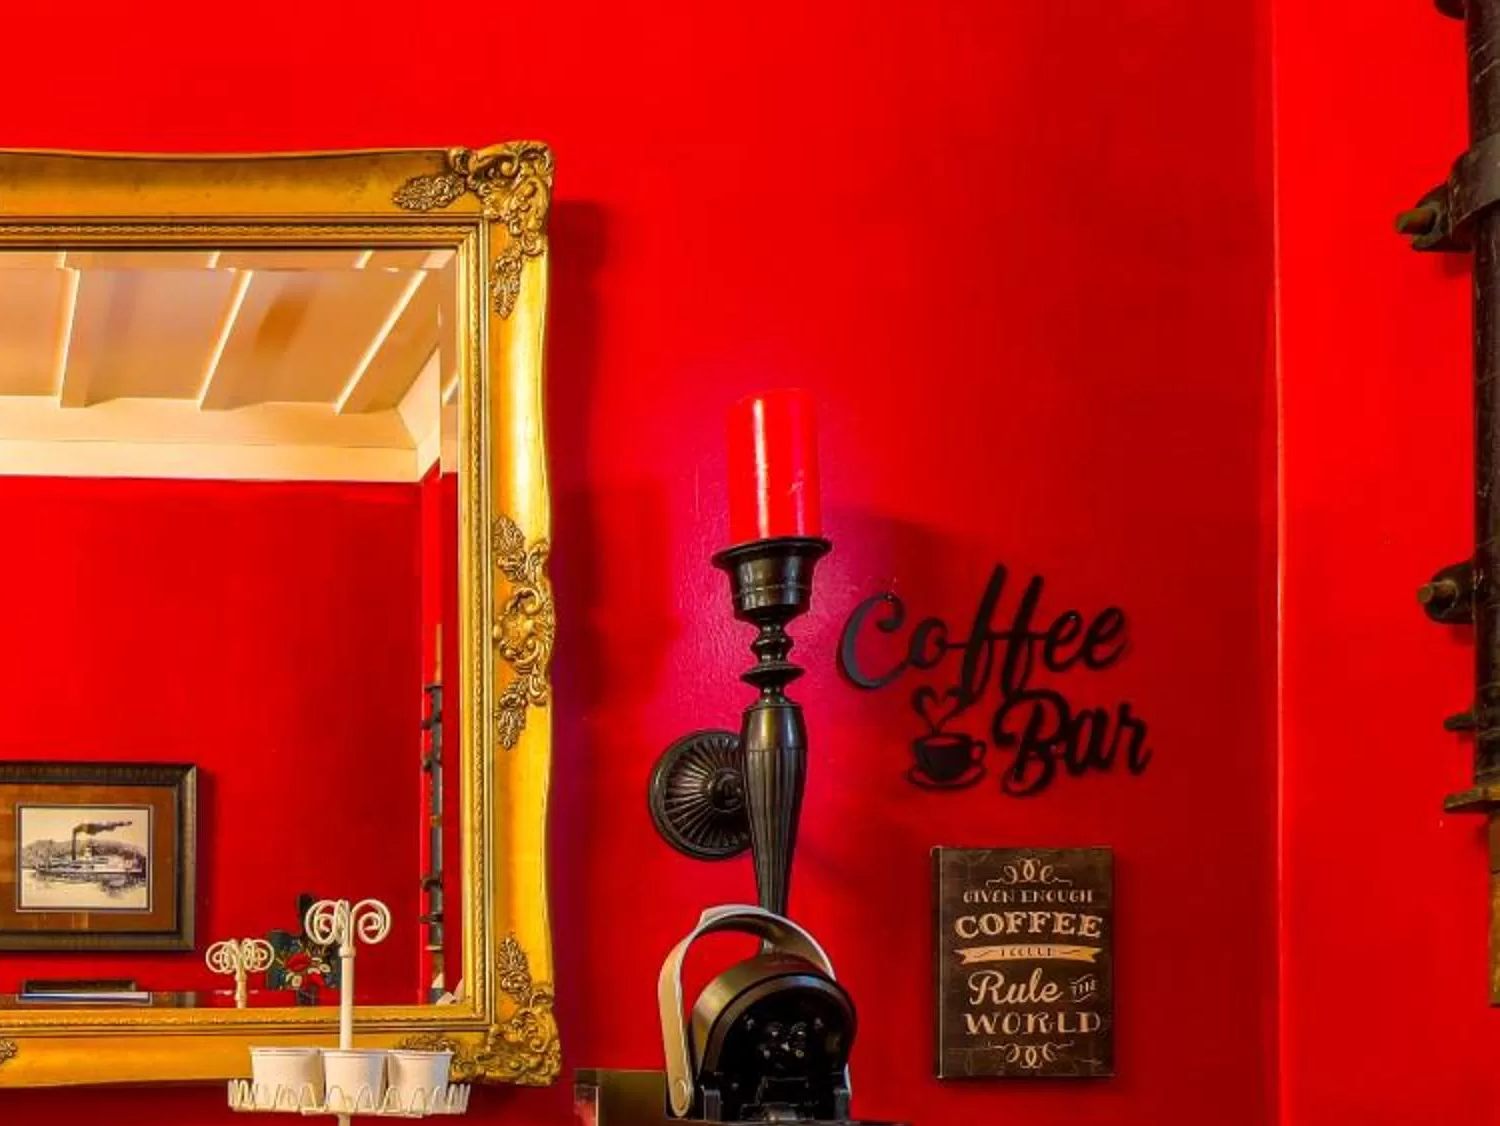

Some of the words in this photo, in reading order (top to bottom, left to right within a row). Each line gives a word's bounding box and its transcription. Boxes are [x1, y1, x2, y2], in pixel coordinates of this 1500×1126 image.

[838, 563, 1128, 700] Coffee
[992, 688, 1152, 796] Bar
[963, 889, 1015, 903] GIVEN
[1021, 889, 1093, 903] ENOUGH
[954, 910, 1103, 939] COFFEE
[968, 967, 1064, 1005] Rule
[964, 1011, 1101, 1035] WORLD
